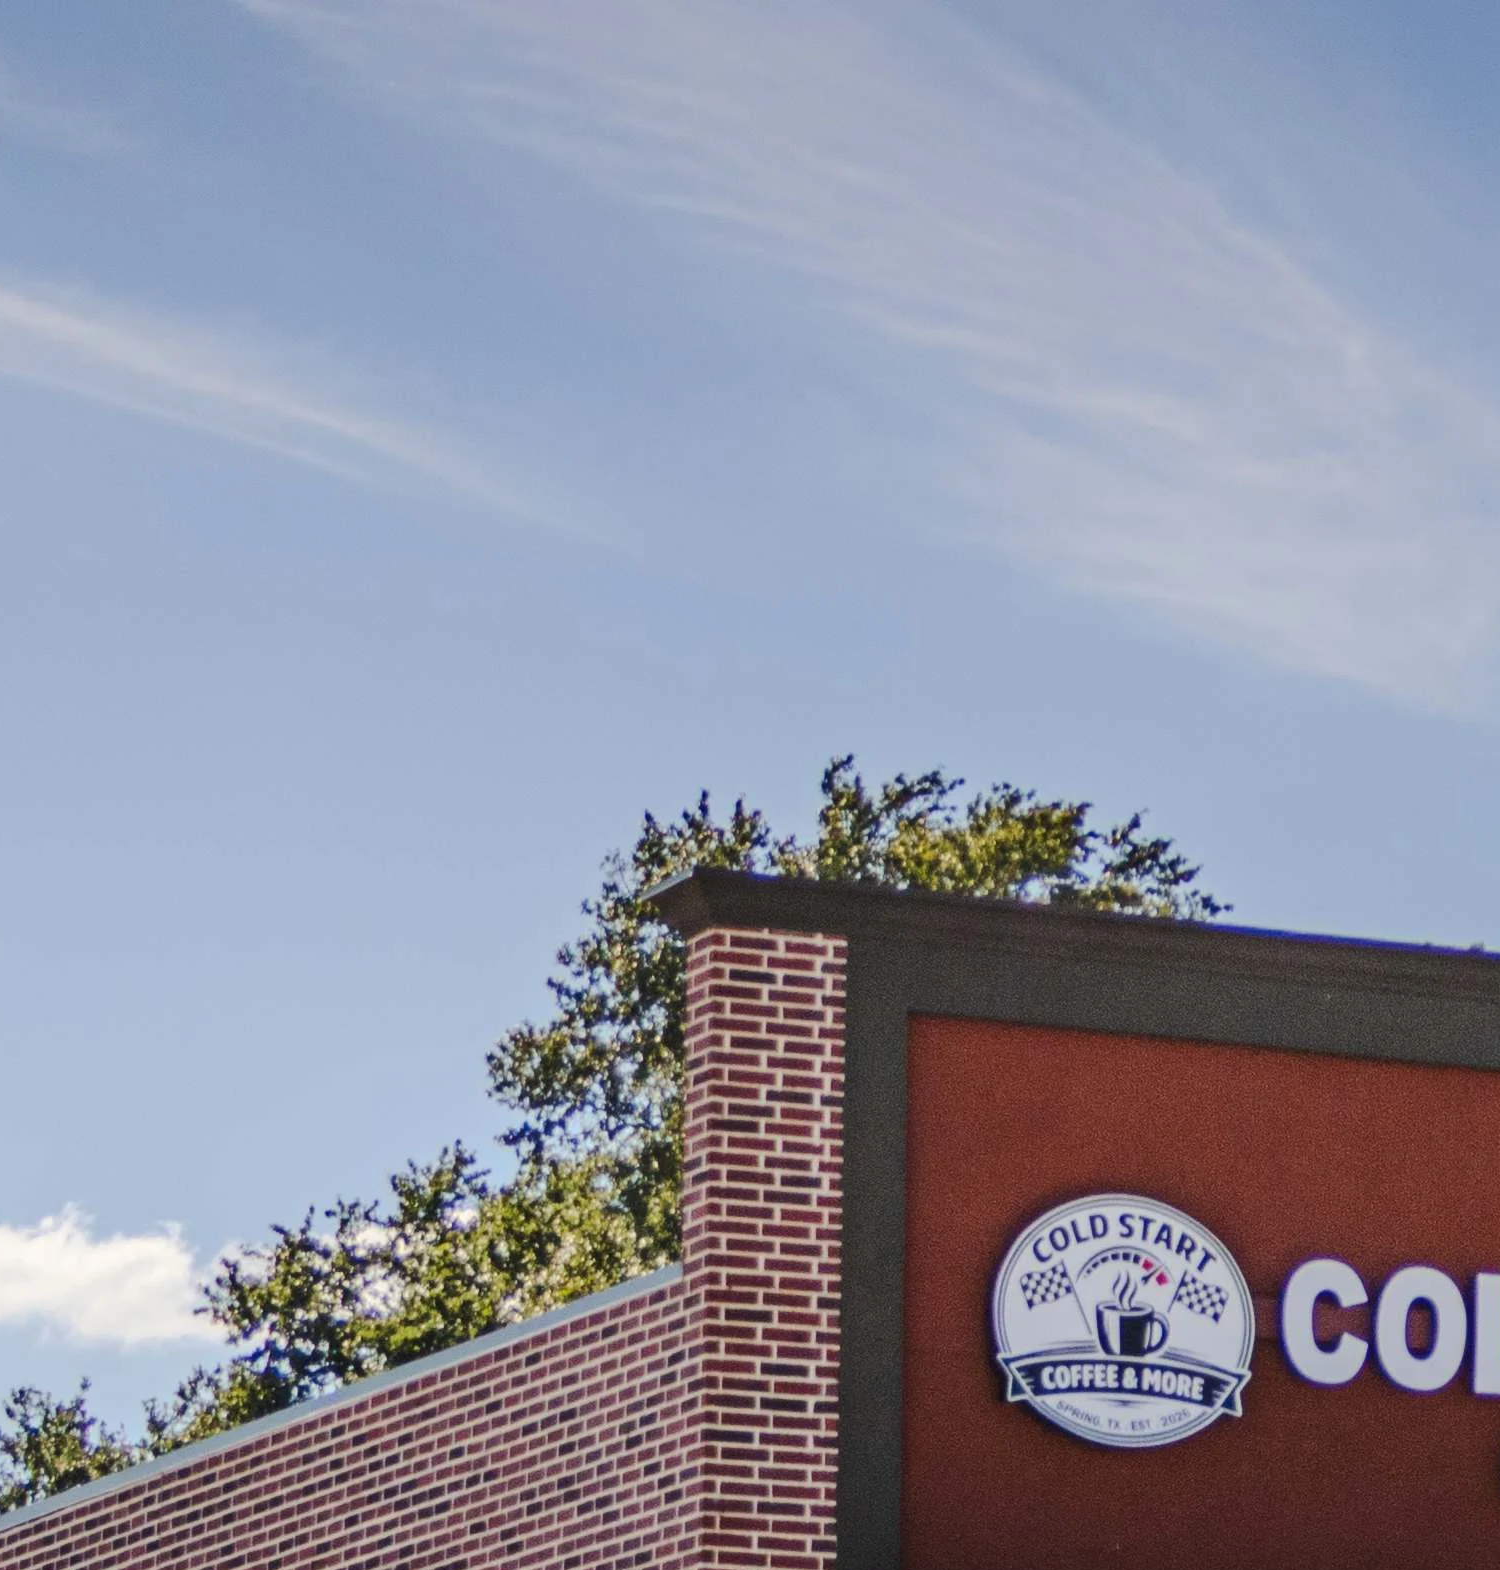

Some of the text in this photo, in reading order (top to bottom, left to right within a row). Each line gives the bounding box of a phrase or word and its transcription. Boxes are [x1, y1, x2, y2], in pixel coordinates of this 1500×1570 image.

[1032, 1212, 1217, 1274] COLD START
[1040, 1363, 1205, 1400] COFFEE & MORE
